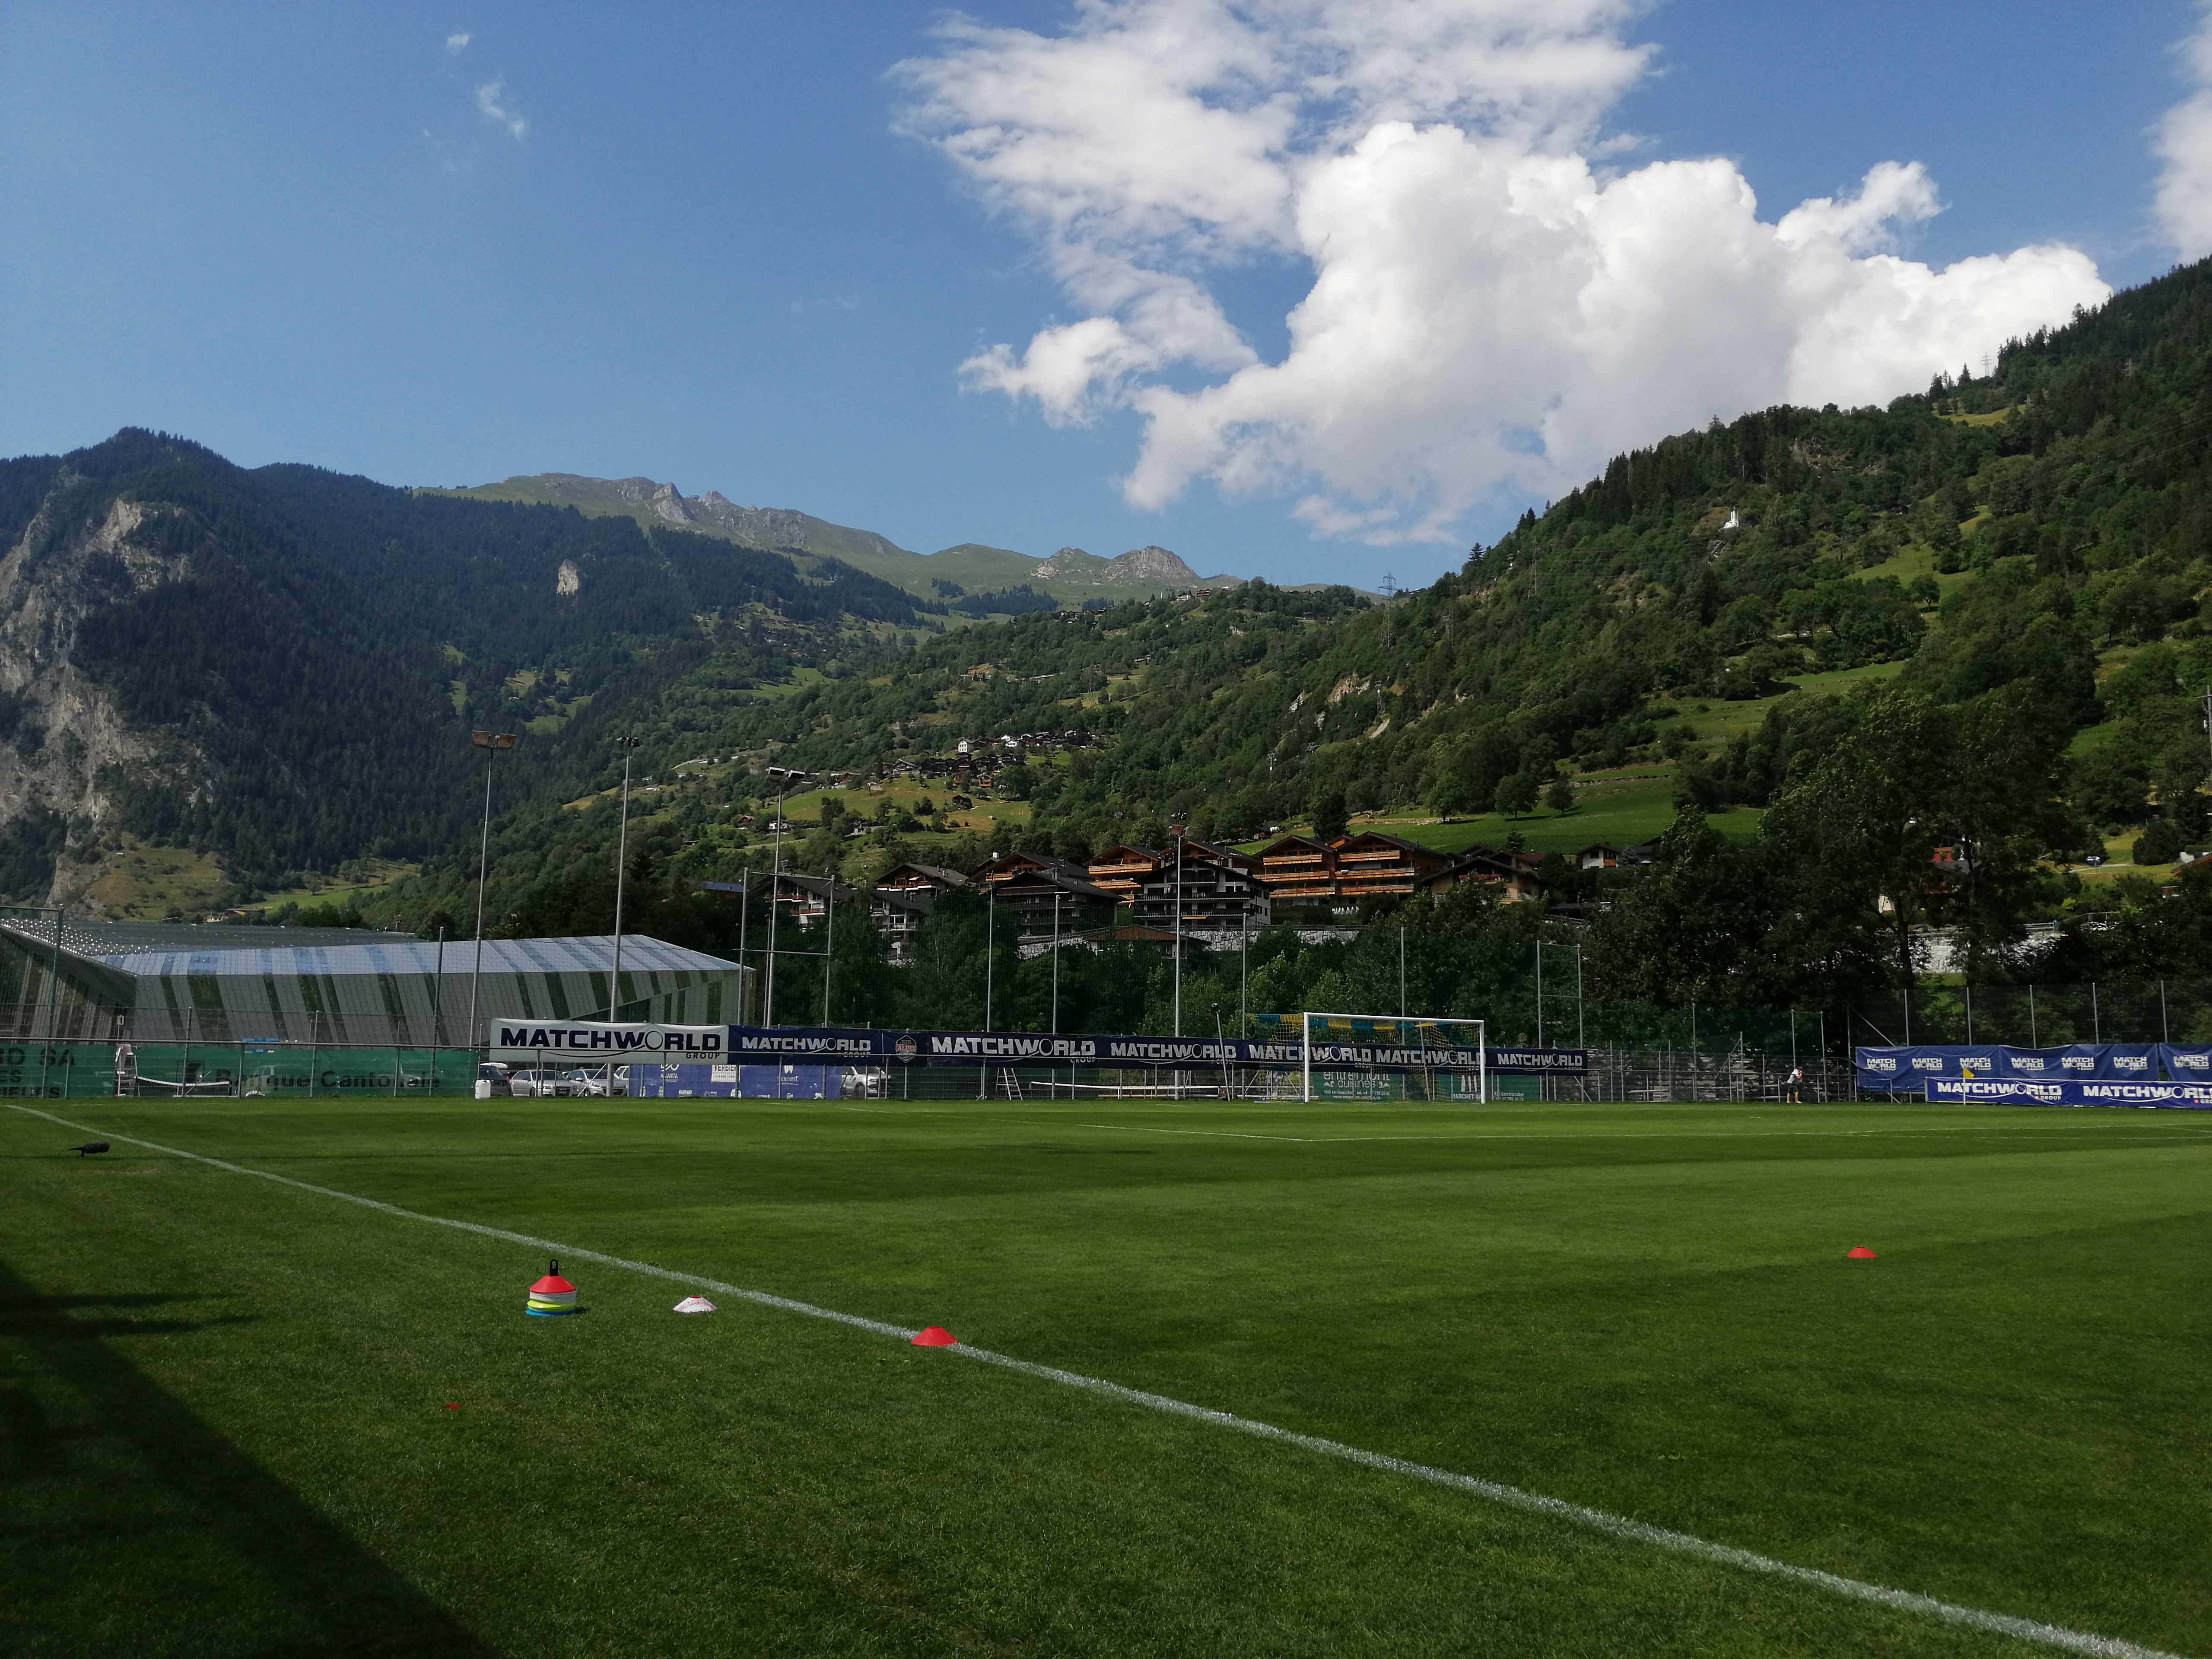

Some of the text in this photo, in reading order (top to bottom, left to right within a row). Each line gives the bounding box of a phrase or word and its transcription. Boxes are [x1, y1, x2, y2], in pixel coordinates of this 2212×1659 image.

[501, 1028, 720, 1050] MATCHWORLD
[742, 1037, 871, 1051] MATCHWORLD
[932, 1037, 1096, 1056] MATCHWORLD
[1111, 1042, 1236, 1058] MATCHWORLD
[1497, 1053, 1583, 1066] MATCHWORLD
[1937, 1082, 2062, 1095] MATCHWORLD
